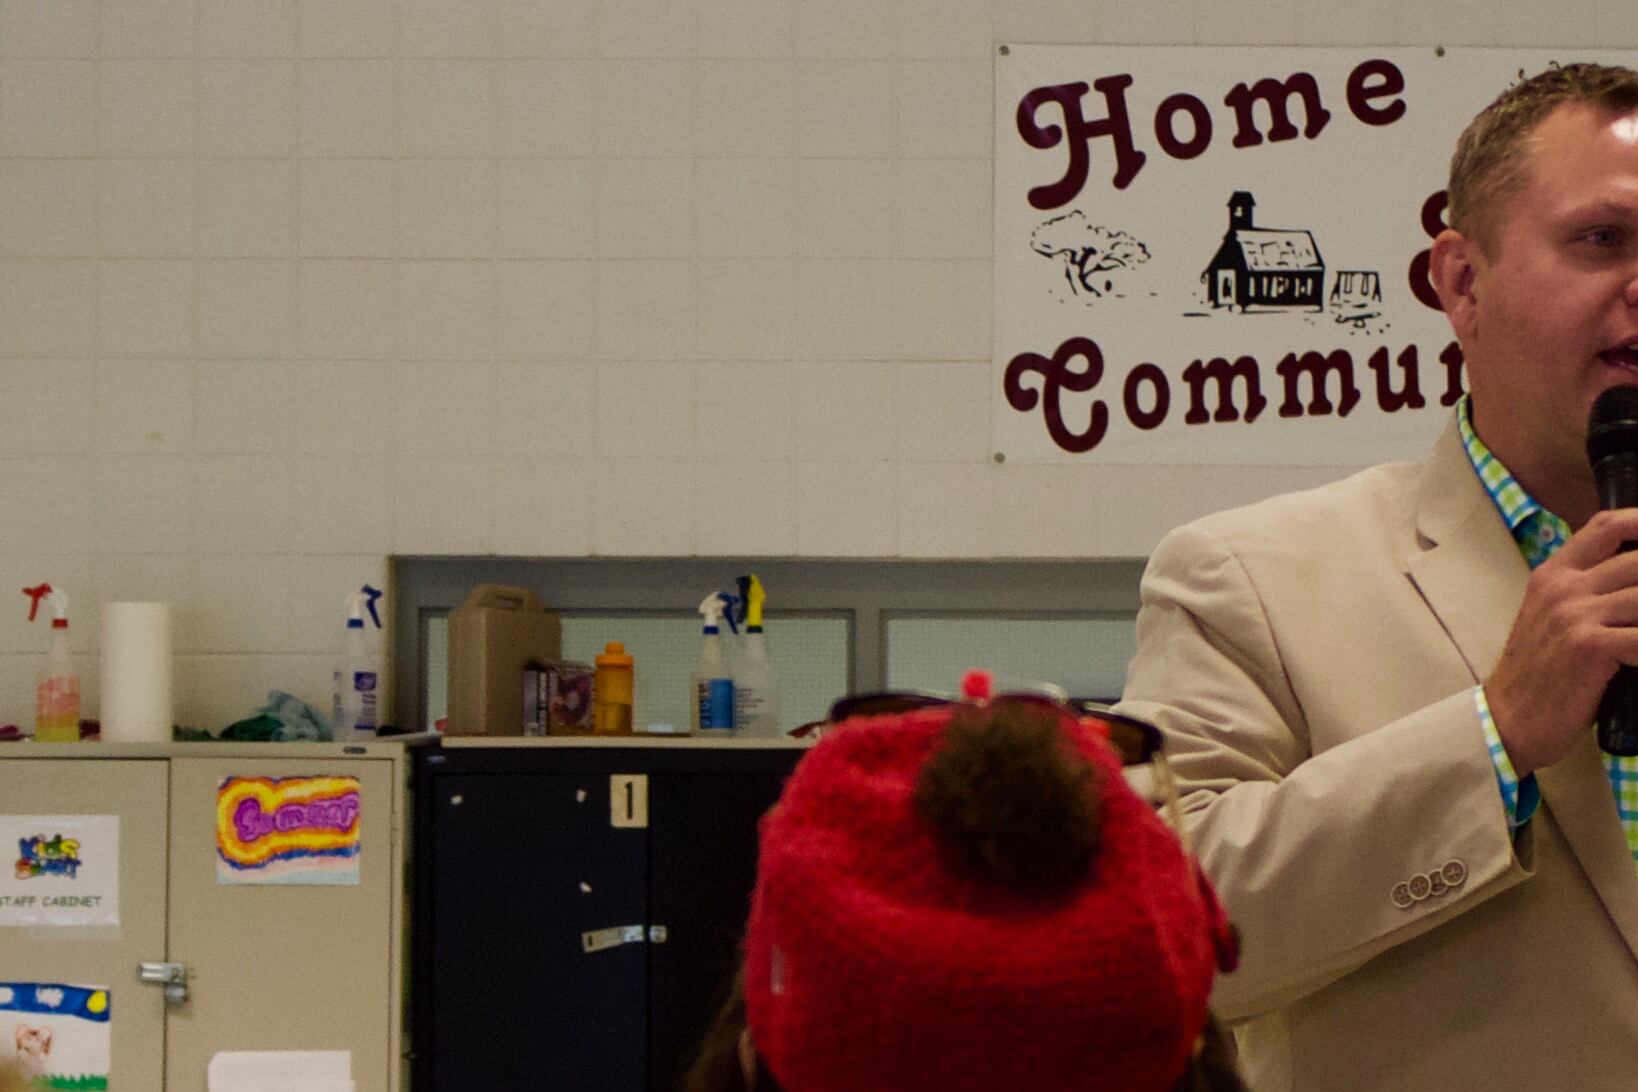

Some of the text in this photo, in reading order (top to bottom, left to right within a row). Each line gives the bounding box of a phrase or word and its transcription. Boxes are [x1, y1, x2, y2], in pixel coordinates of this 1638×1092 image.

[1015, 57, 1407, 211] Home
[621, 781, 634, 820] 1
[41, 895, 102, 907] CABINET
